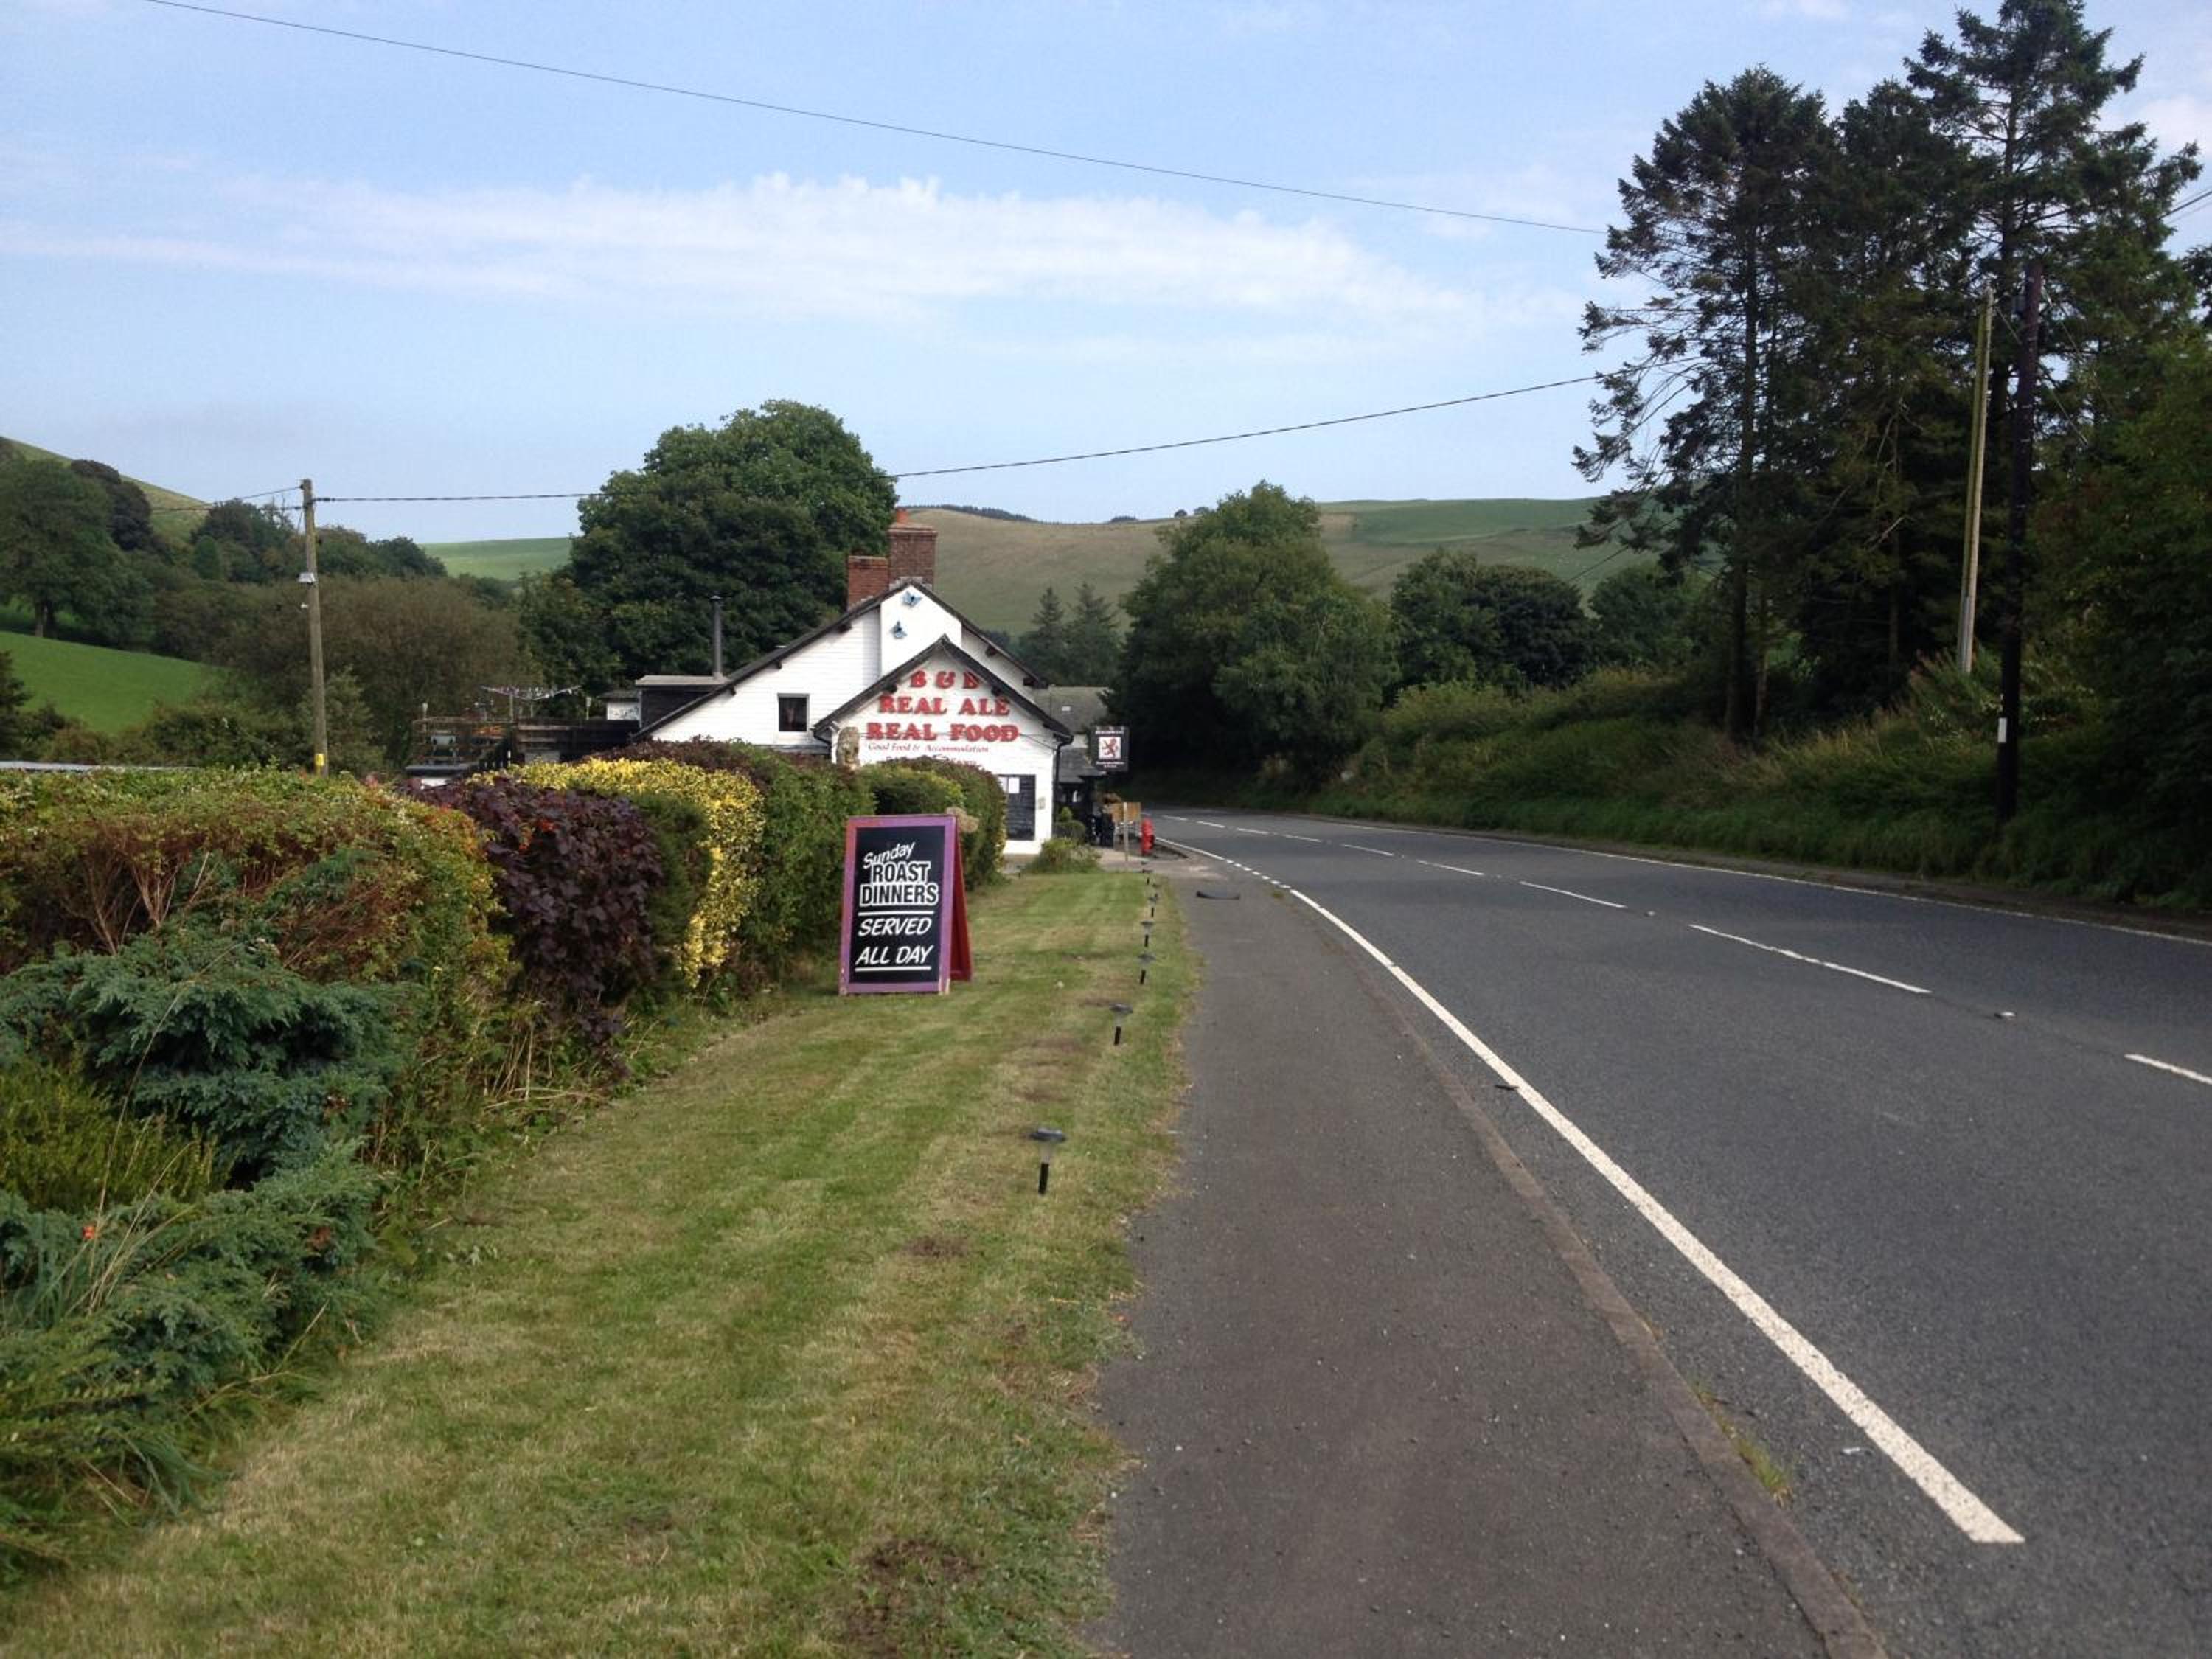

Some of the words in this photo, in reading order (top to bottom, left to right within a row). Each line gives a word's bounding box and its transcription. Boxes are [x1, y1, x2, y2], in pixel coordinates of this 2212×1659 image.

[910, 669, 927, 688] B
[935, 670, 956, 689] &
[878, 695, 947, 714] REAL
[958, 697, 1011, 716] ALE
[866, 721, 937, 740] REAL
[950, 723, 1019, 742] FOOD
[868, 742, 890, 751] Good
[891, 743, 911, 752] Food
[863, 841, 916, 869] Sunday
[870, 860, 931, 884] ROAST
[859, 883, 939, 907] DINNERS
[858, 917, 932, 937] SERVED
[855, 945, 891, 965] ALL
[895, 945, 934, 964] DAY
